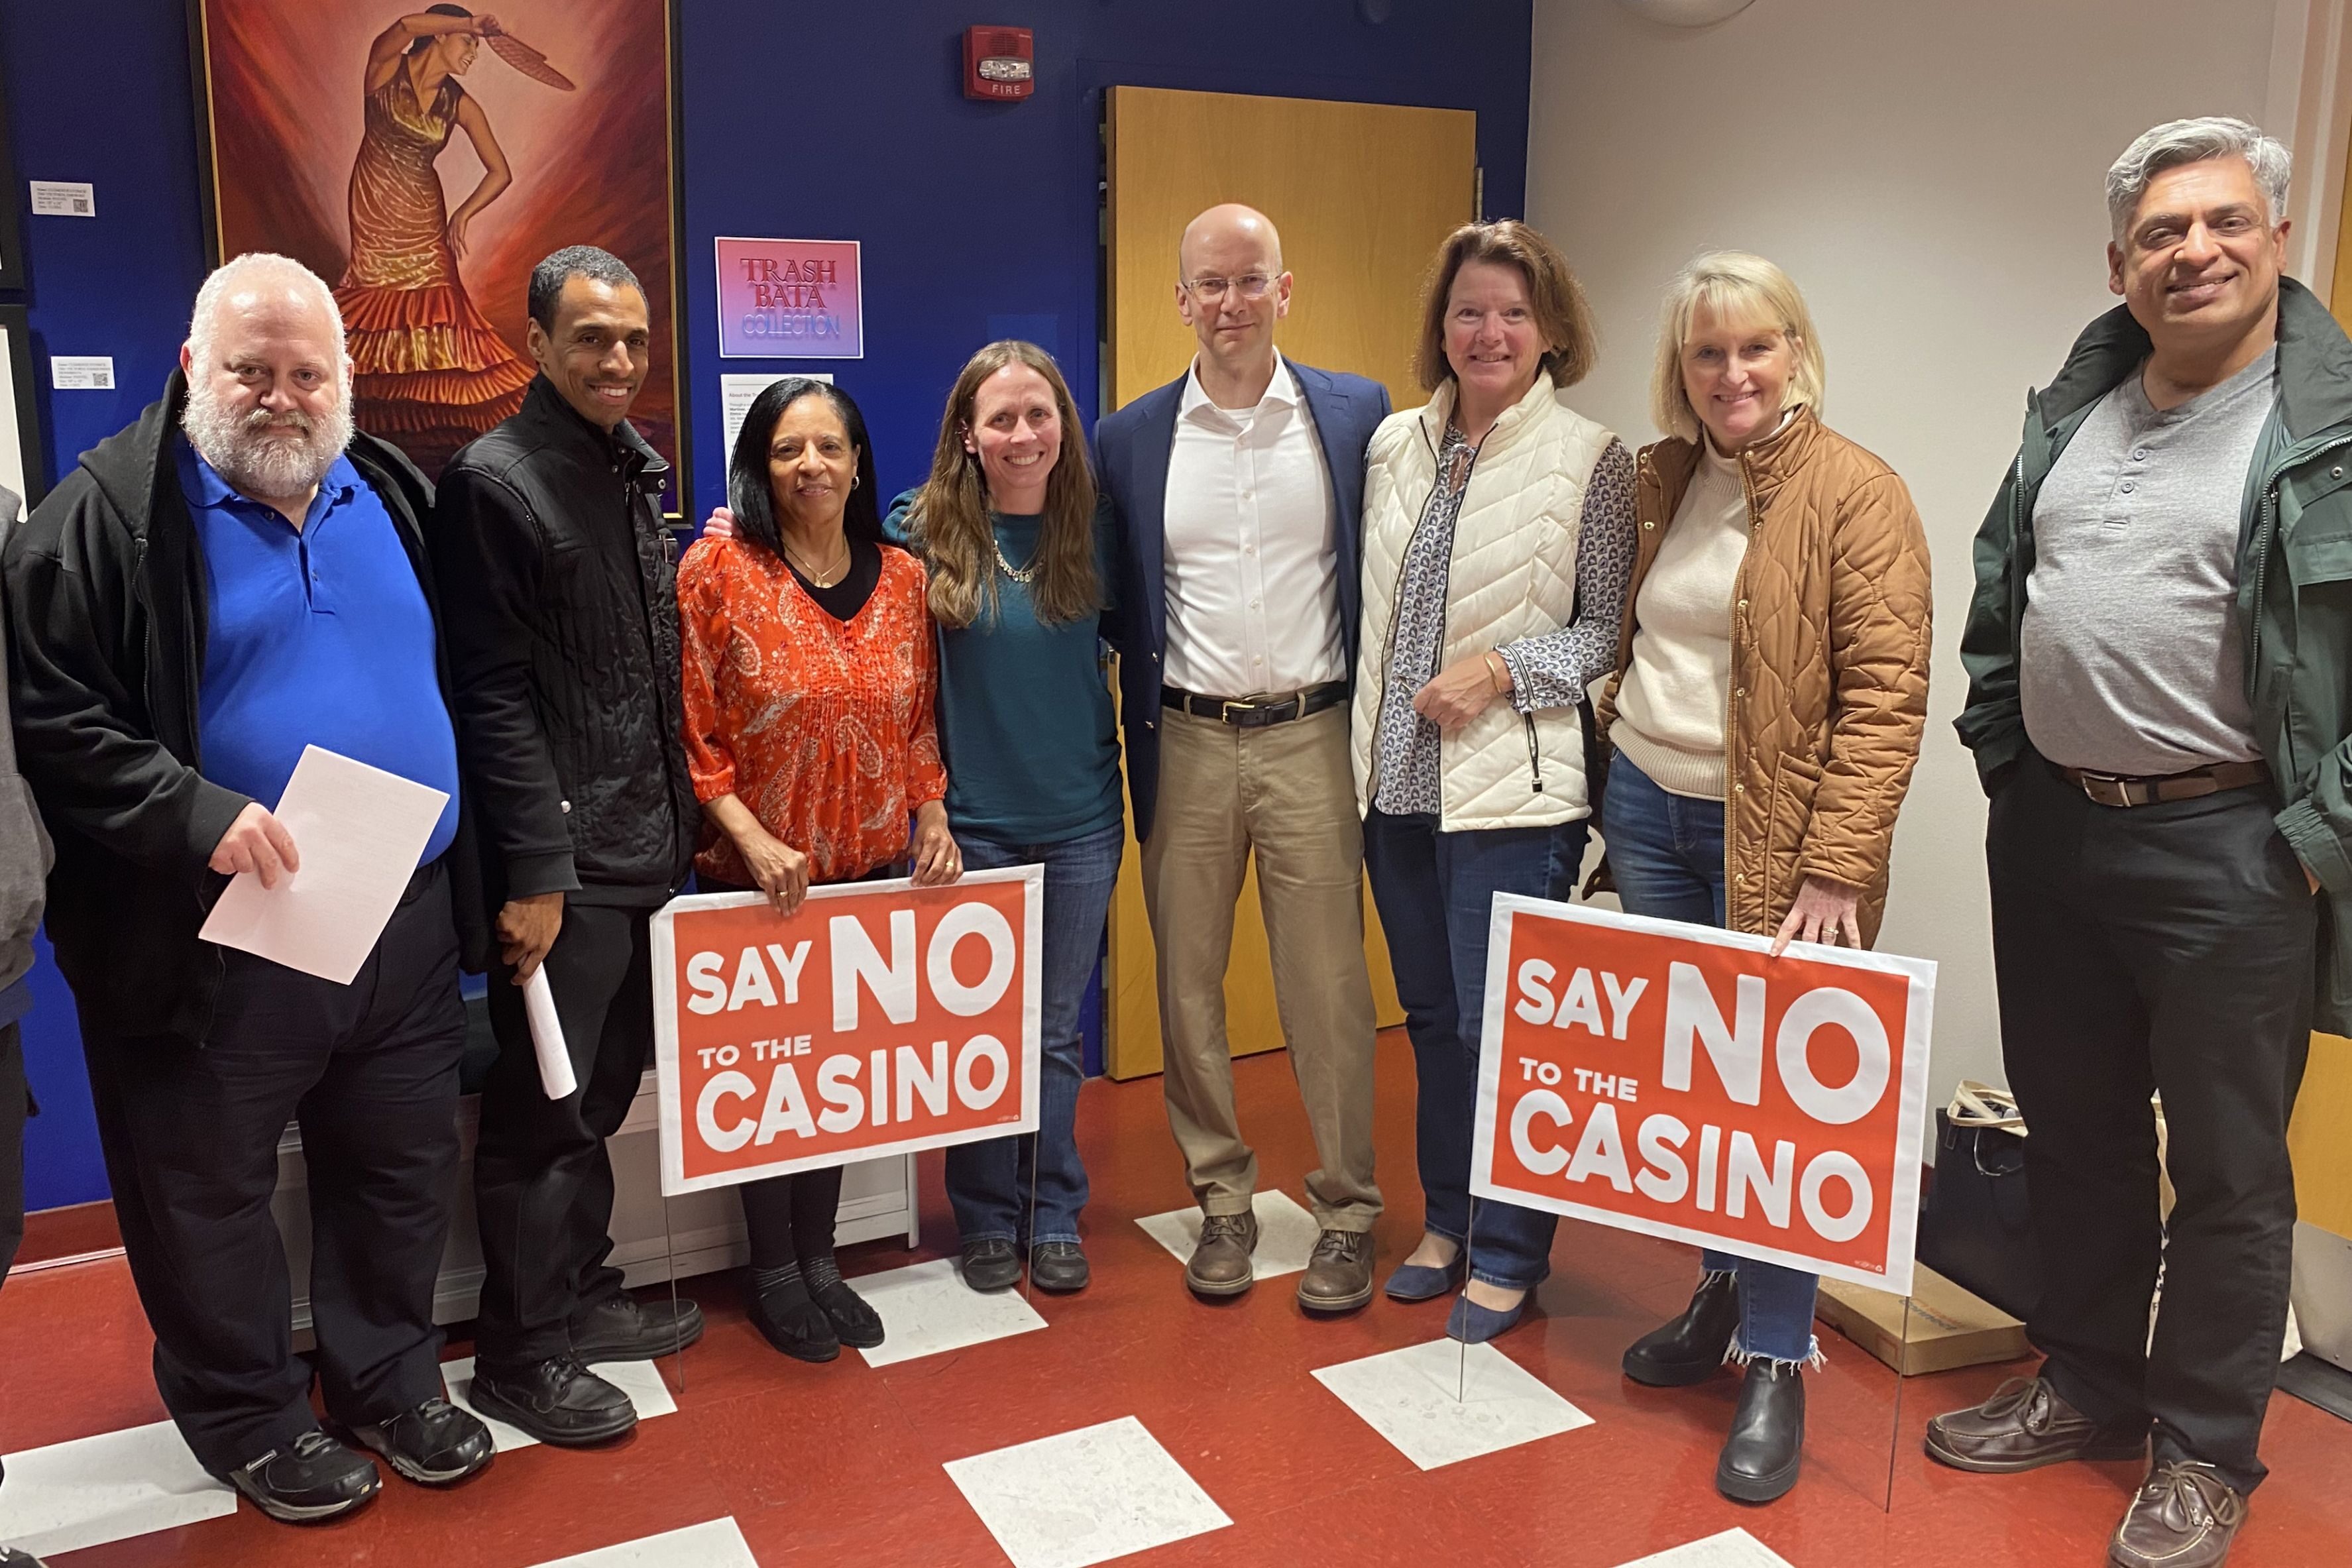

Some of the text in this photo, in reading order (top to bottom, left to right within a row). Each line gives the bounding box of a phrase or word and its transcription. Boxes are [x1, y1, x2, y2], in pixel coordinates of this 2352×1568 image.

[992, 84, 1021, 95] FIRE
[740, 258, 837, 284] TRASH
[755, 284, 828, 309] BATA
[742, 314, 840, 337] COLLECTION
[686, 901, 1016, 1033] SAY NO
[697, 1034, 812, 1069] TO THE
[1514, 958, 1891, 1125] SAY NO
[696, 1034, 1010, 1152] CASINO
[1518, 1056, 1638, 1102] TO THE
[1510, 1089, 1874, 1243] CASINO
